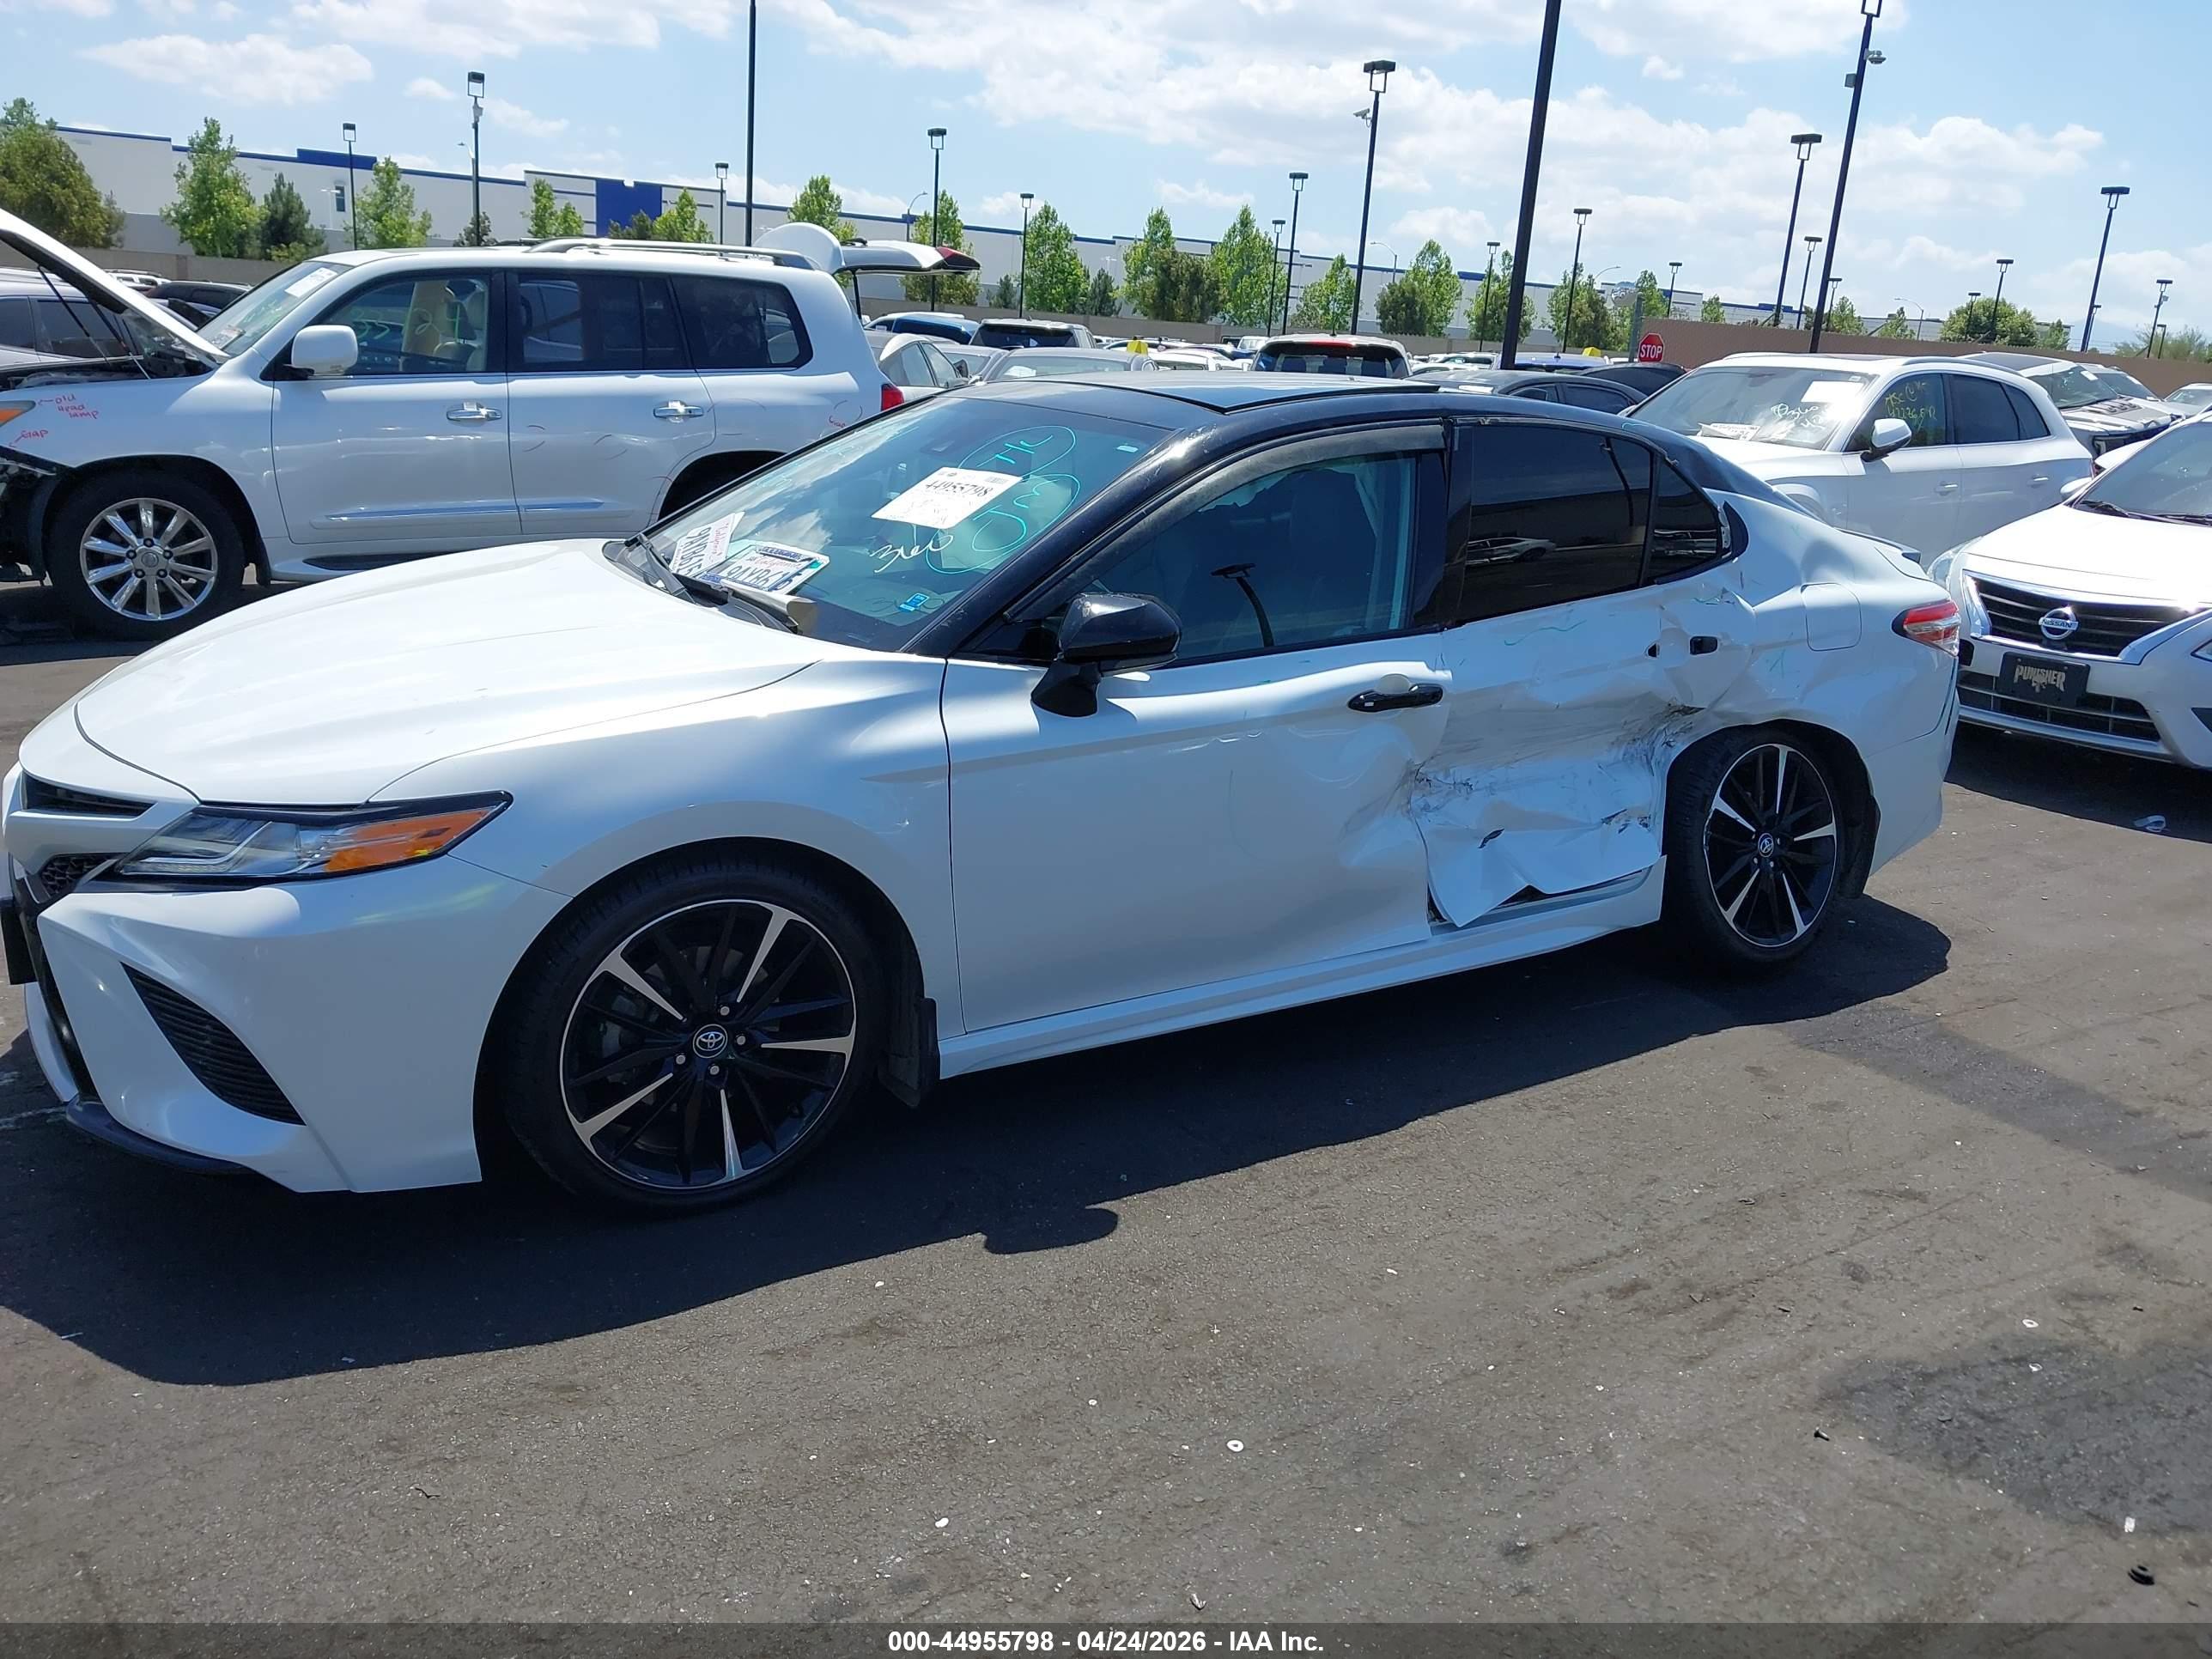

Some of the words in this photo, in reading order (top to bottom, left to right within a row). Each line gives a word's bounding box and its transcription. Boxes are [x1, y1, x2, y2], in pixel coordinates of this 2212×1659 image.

[1640, 344, 1662, 359] STOP
[926, 480, 994, 497] 44955798
[2043, 618, 2072, 628] NISSAN
[2014, 665, 2066, 692] PUNISHER
